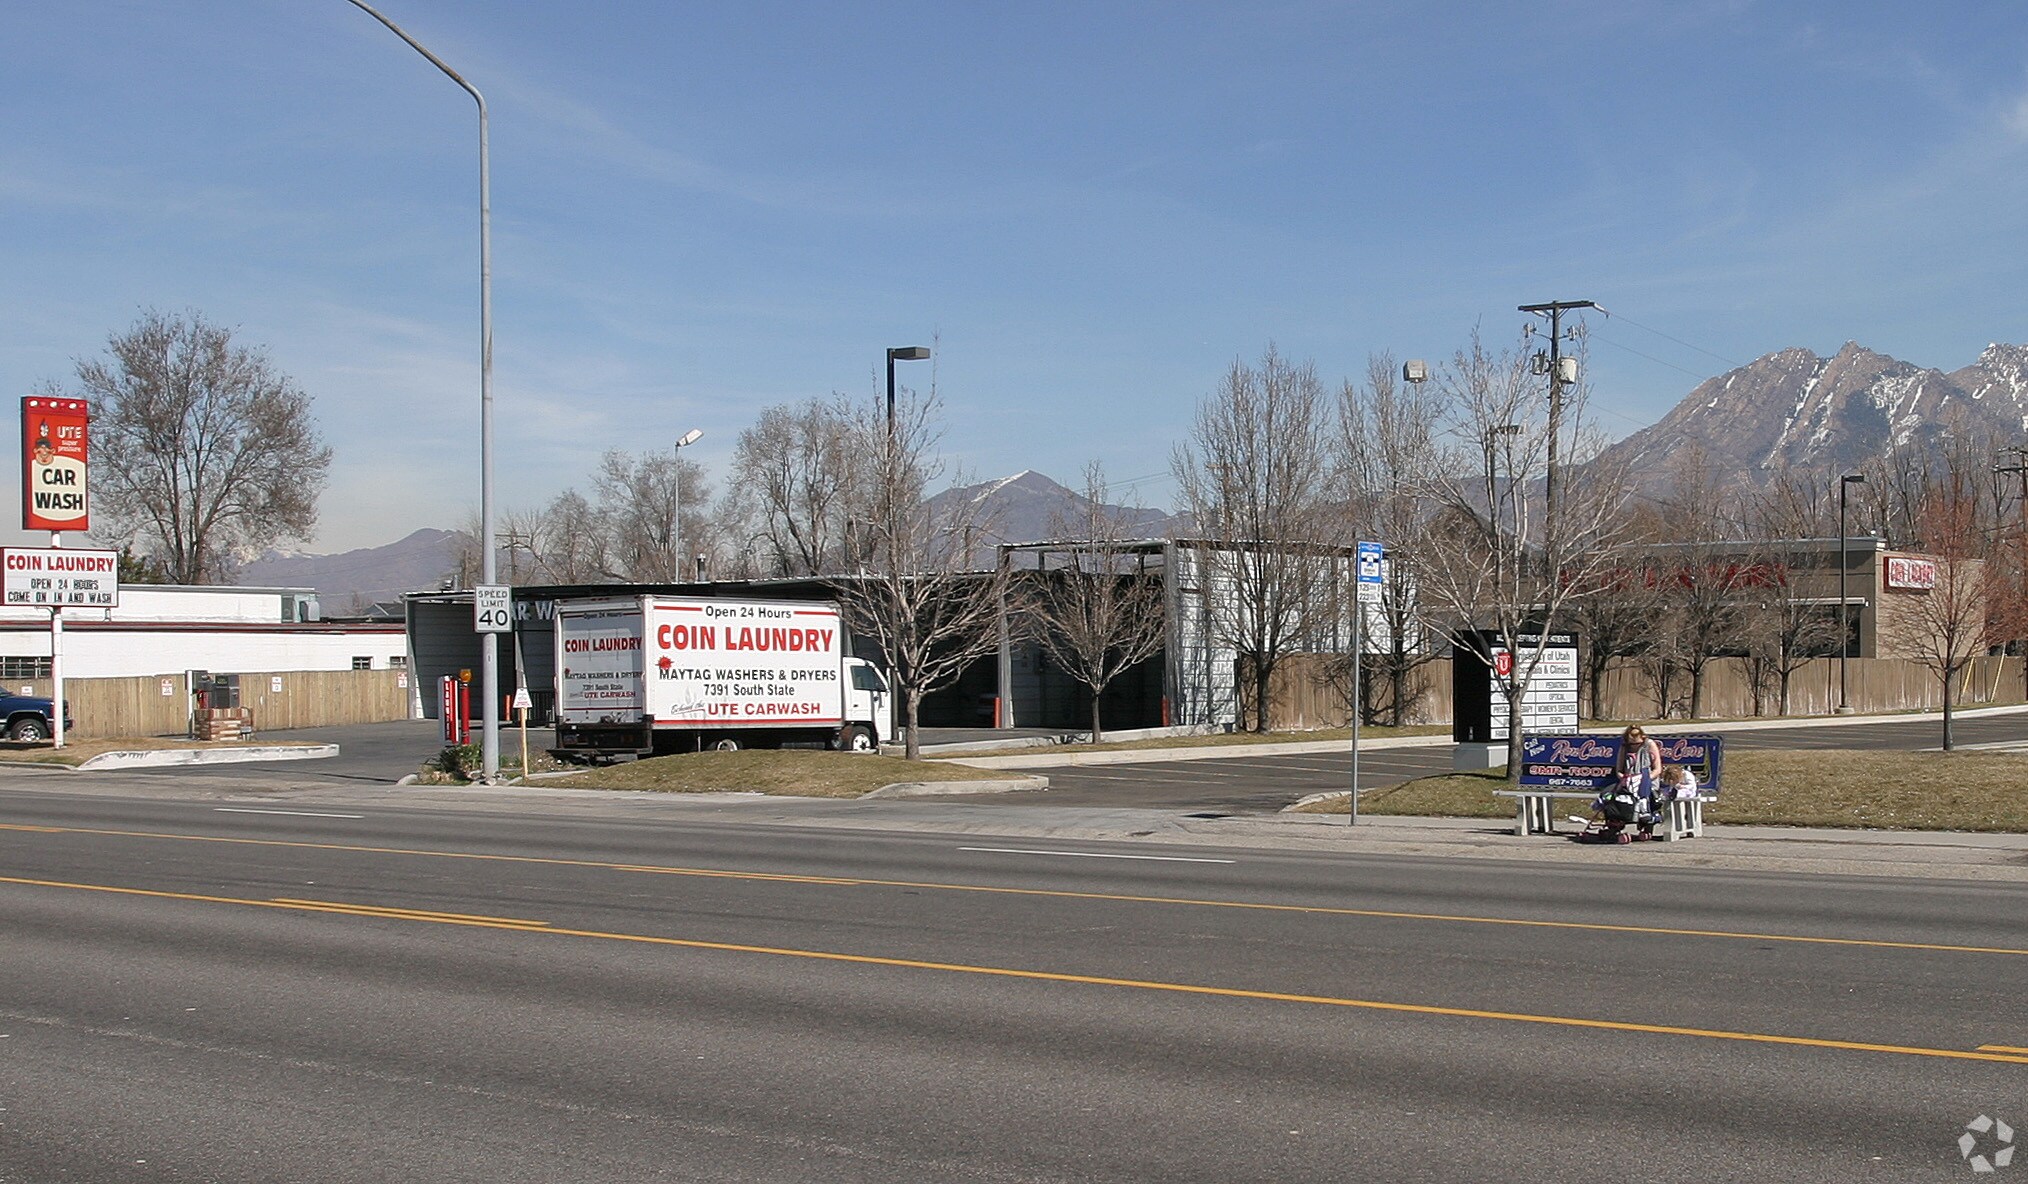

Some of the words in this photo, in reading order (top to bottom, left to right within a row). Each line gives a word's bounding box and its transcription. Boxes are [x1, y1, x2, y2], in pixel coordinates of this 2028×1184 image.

[57, 425, 83, 439] UTE
[42, 468, 76, 487] CAR
[35, 491, 83, 511] WASH
[7, 555, 42, 571] COIN
[47, 556, 115, 573] LAUNDRY
[31, 578, 52, 590] OPEN
[58, 579, 68, 590] 24
[8, 591, 30, 603] COME
[36, 592, 47, 603] ON
[54, 592, 63, 603] IN
[68, 592, 84, 604] AND
[89, 592, 112, 604] WASH
[478, 590, 508, 599] SPEED
[481, 599, 504, 608] LIMIT
[478, 609, 508, 626] 40
[705, 605, 737, 620] Open
[740, 607, 755, 618] 24
[758, 607, 792, 619] Hours
[565, 639, 589, 653] COIN
[593, 636, 642, 652] LAUNDRY
[657, 624, 716, 650] COIN
[725, 626, 833, 652] LAUNDRY
[1554, 650, 1571, 661] Utah
[659, 668, 712, 681] MAYTAG
[716, 669, 775, 681] WASHERS
[778, 669, 787, 681] &
[791, 669, 837, 681] DRYERS
[703, 683, 729, 696] 7391
[733, 683, 764, 696] South
[767, 683, 795, 696] State
[708, 702, 739, 716] UTE
[744, 702, 821, 716] CARWASH
